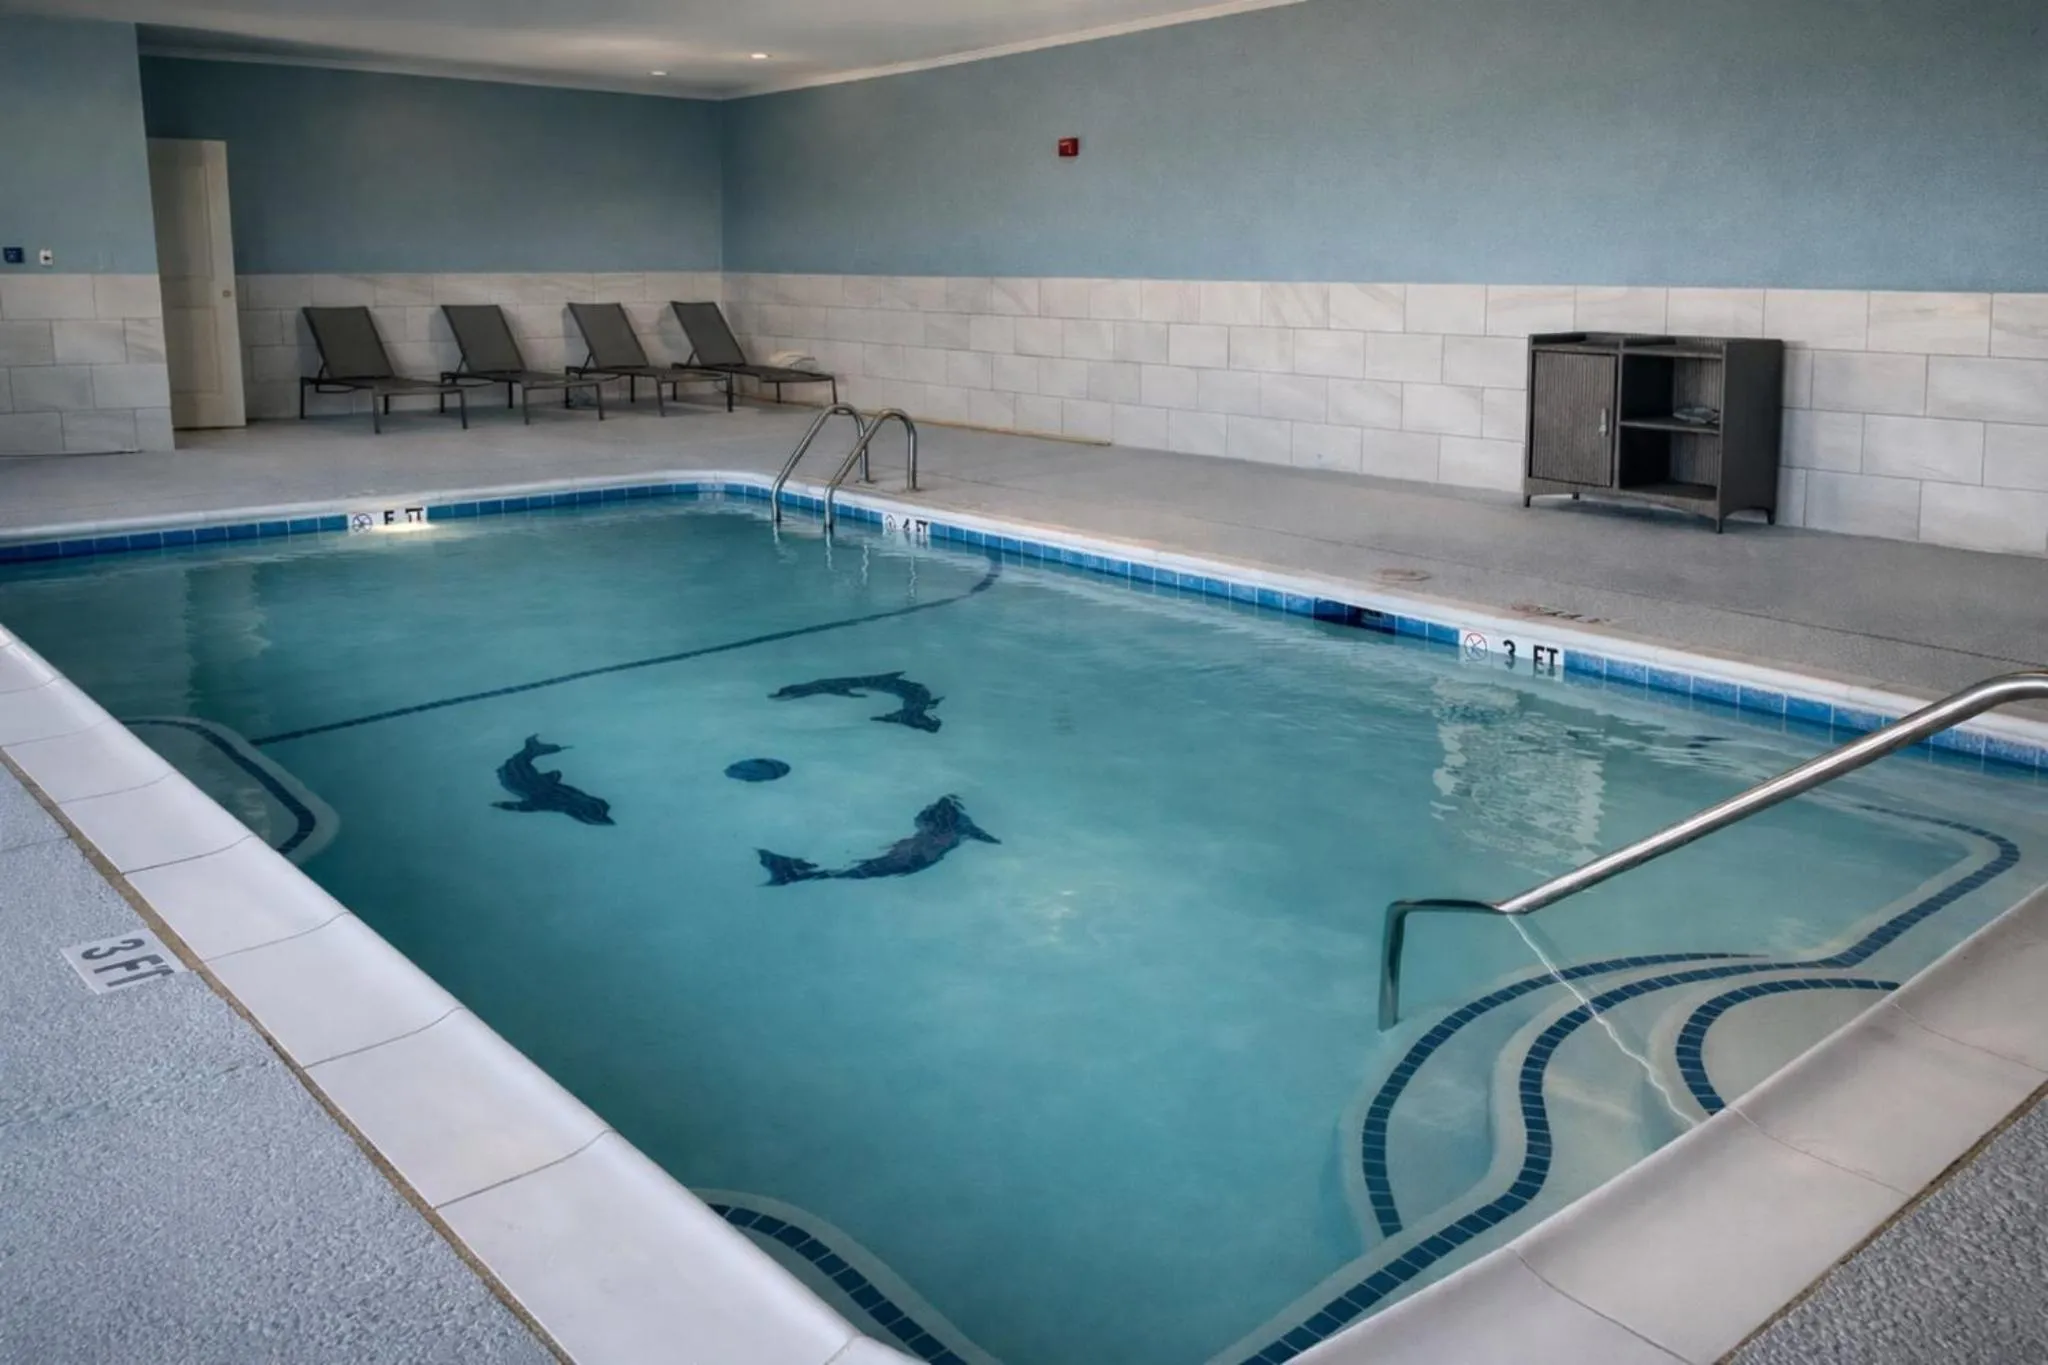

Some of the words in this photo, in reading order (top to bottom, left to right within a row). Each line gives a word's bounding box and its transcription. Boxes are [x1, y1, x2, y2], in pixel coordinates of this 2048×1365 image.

[1502, 639, 1516, 669] 3
[81, 938, 145, 960] 3
[94, 954, 175, 988] FT
